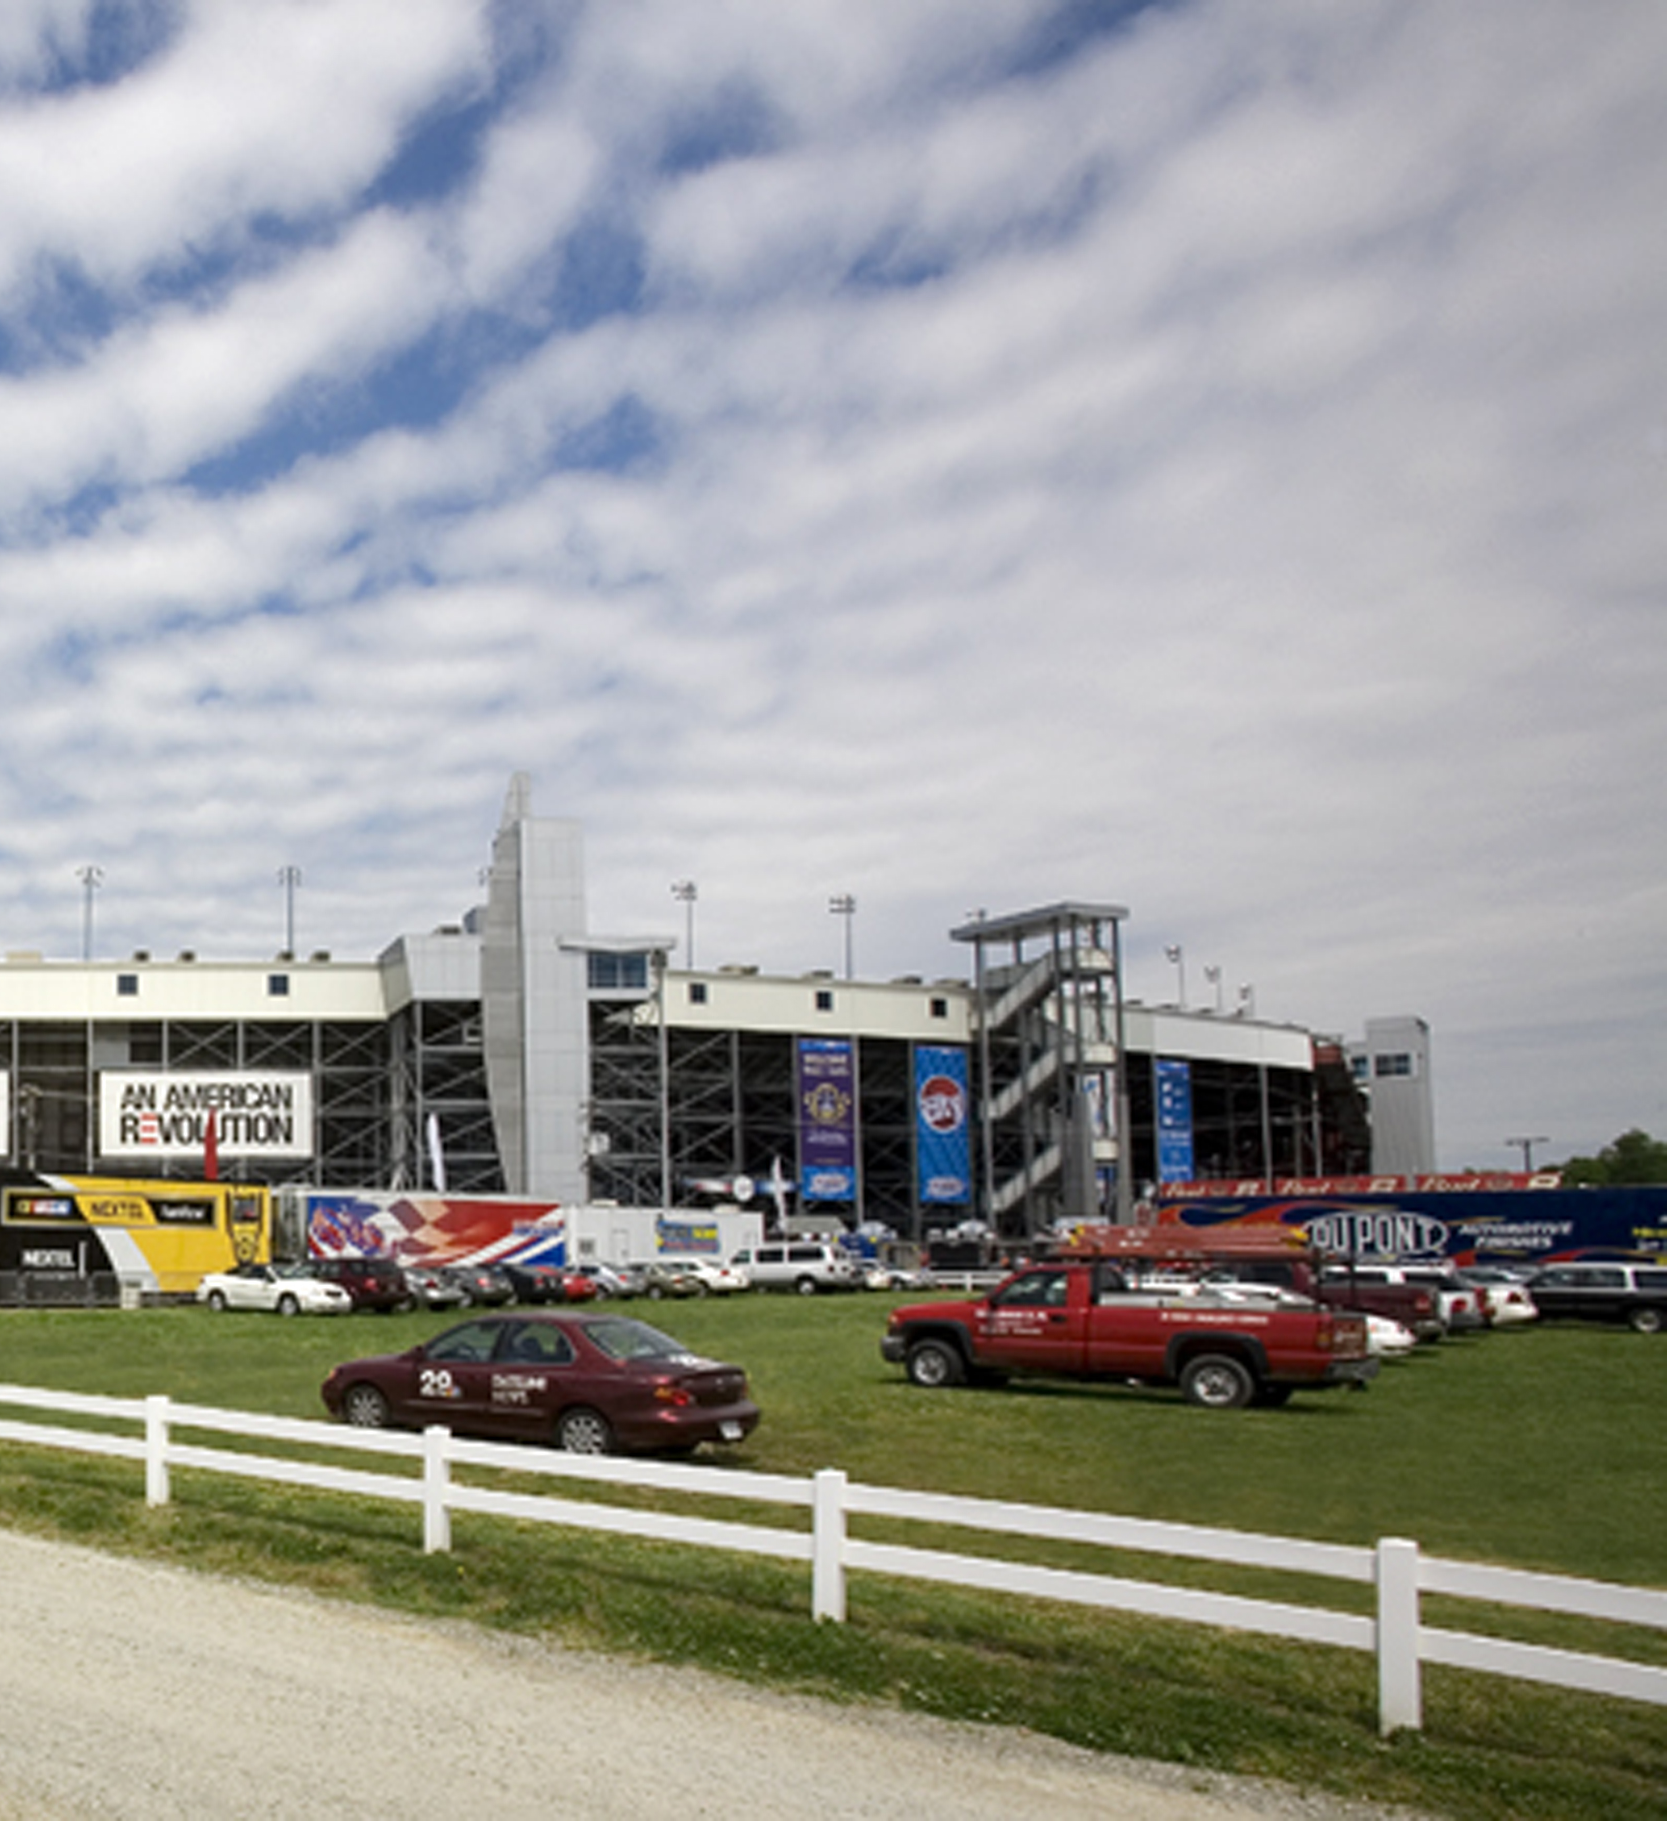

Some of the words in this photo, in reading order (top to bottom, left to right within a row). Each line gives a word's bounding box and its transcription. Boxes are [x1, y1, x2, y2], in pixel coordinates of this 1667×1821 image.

[120, 1083, 156, 1110] AN
[163, 1083, 292, 1110] AMERICAN
[120, 1113, 292, 1145] REVOLUTION
[90, 1201, 143, 1220] NEXTEL
[22, 1249, 75, 1268] NEXTEL
[420, 1369, 452, 1396] 29
